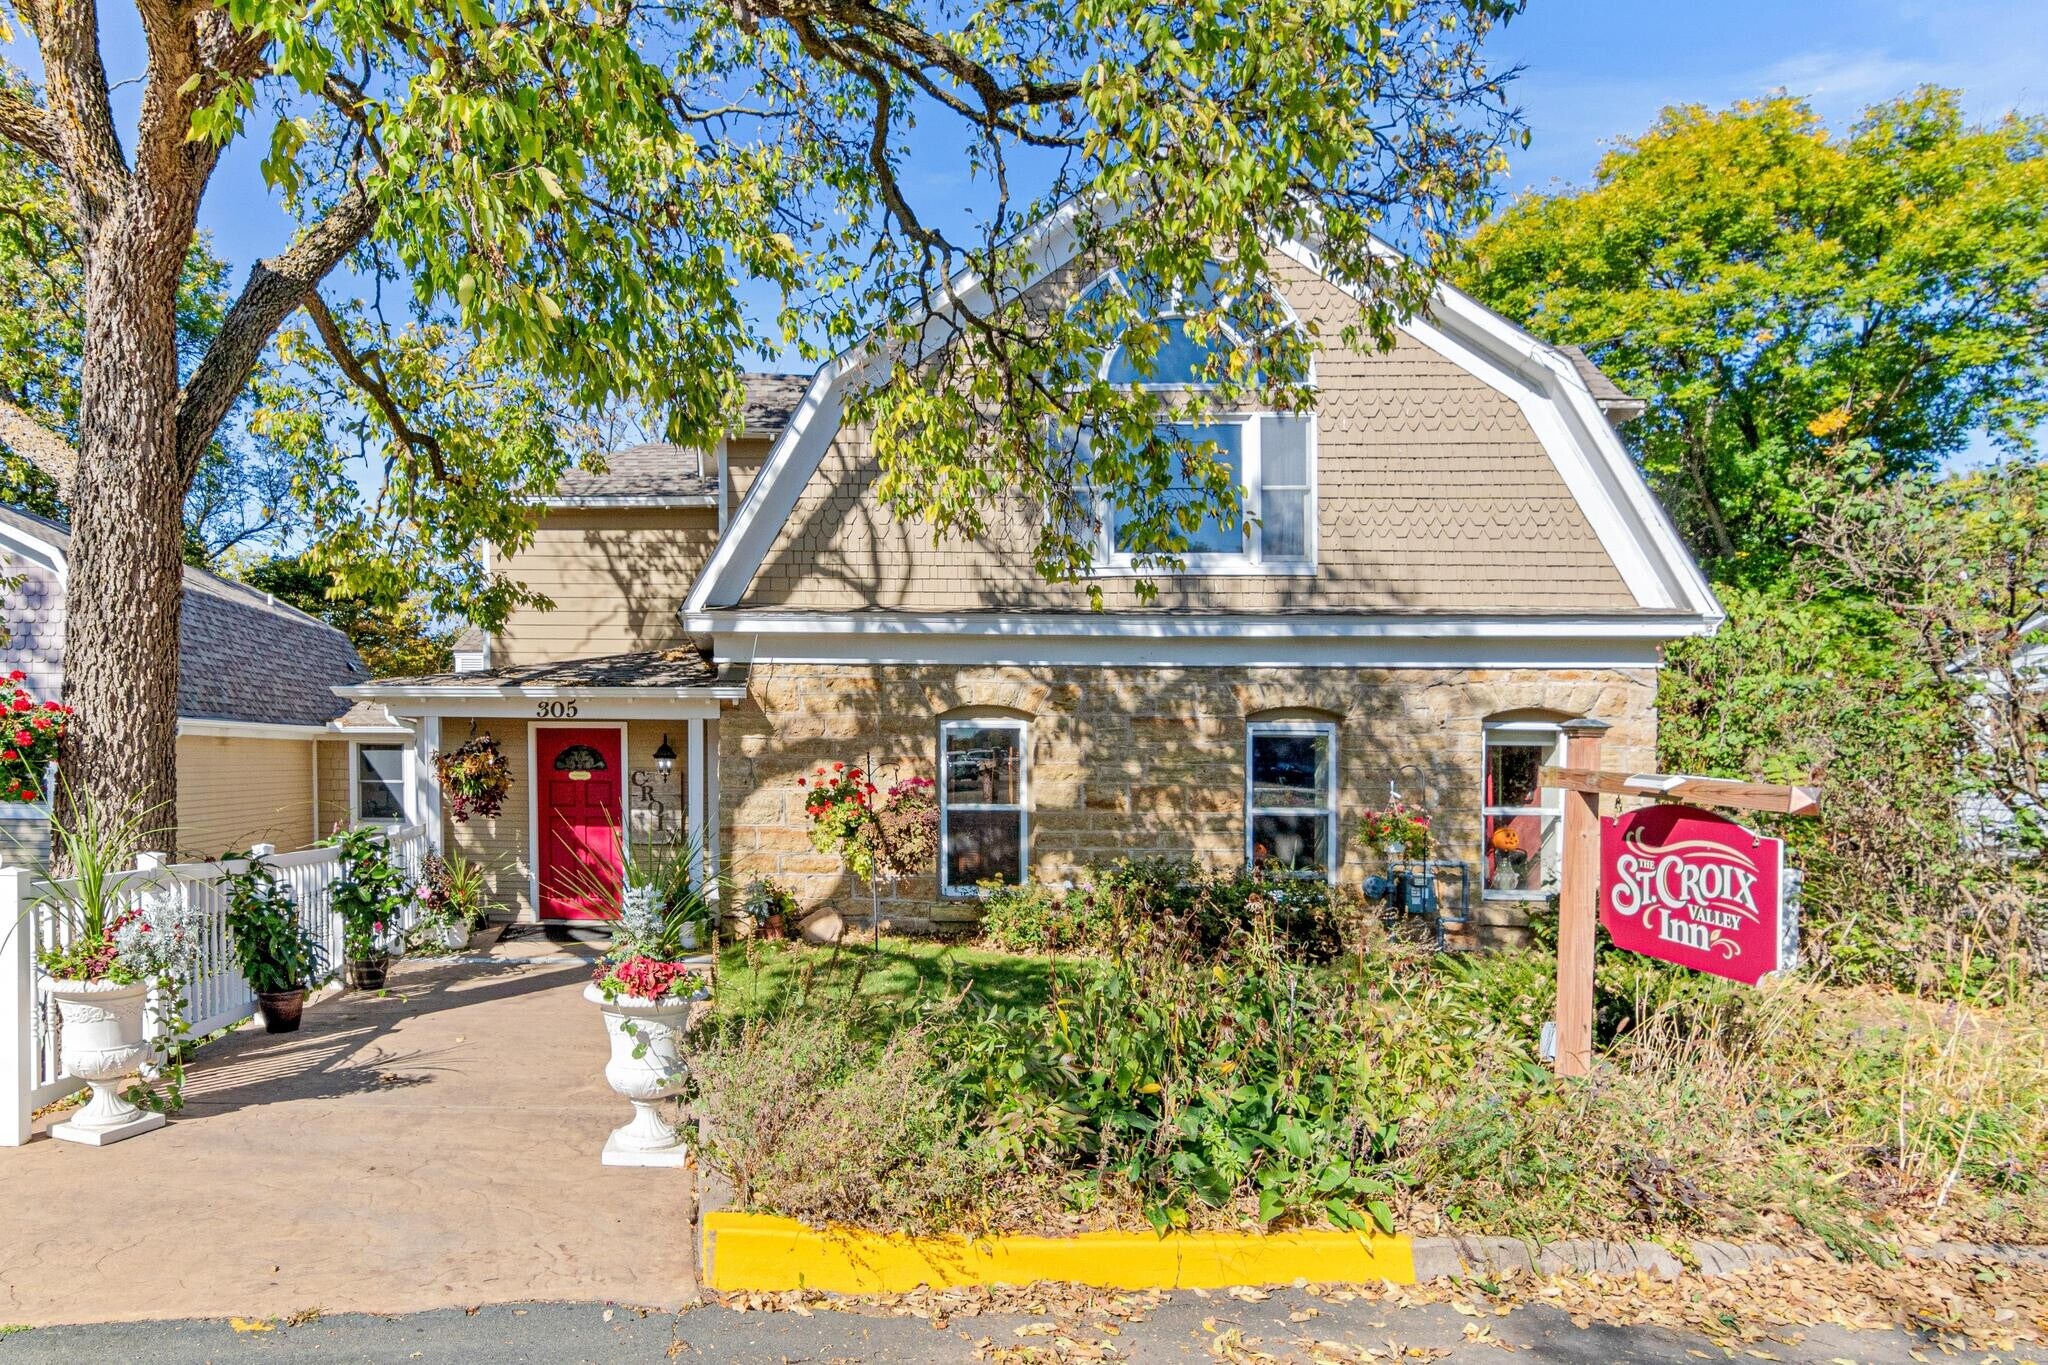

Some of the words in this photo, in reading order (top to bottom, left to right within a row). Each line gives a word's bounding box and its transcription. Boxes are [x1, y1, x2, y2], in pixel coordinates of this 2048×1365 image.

[536, 698, 578, 718] 305
[1638, 858, 1656, 870] THE
[1655, 854, 1760, 915] CROIX
[1658, 907, 1712, 952] Inn
[1687, 903, 1743, 931] VALLEY
